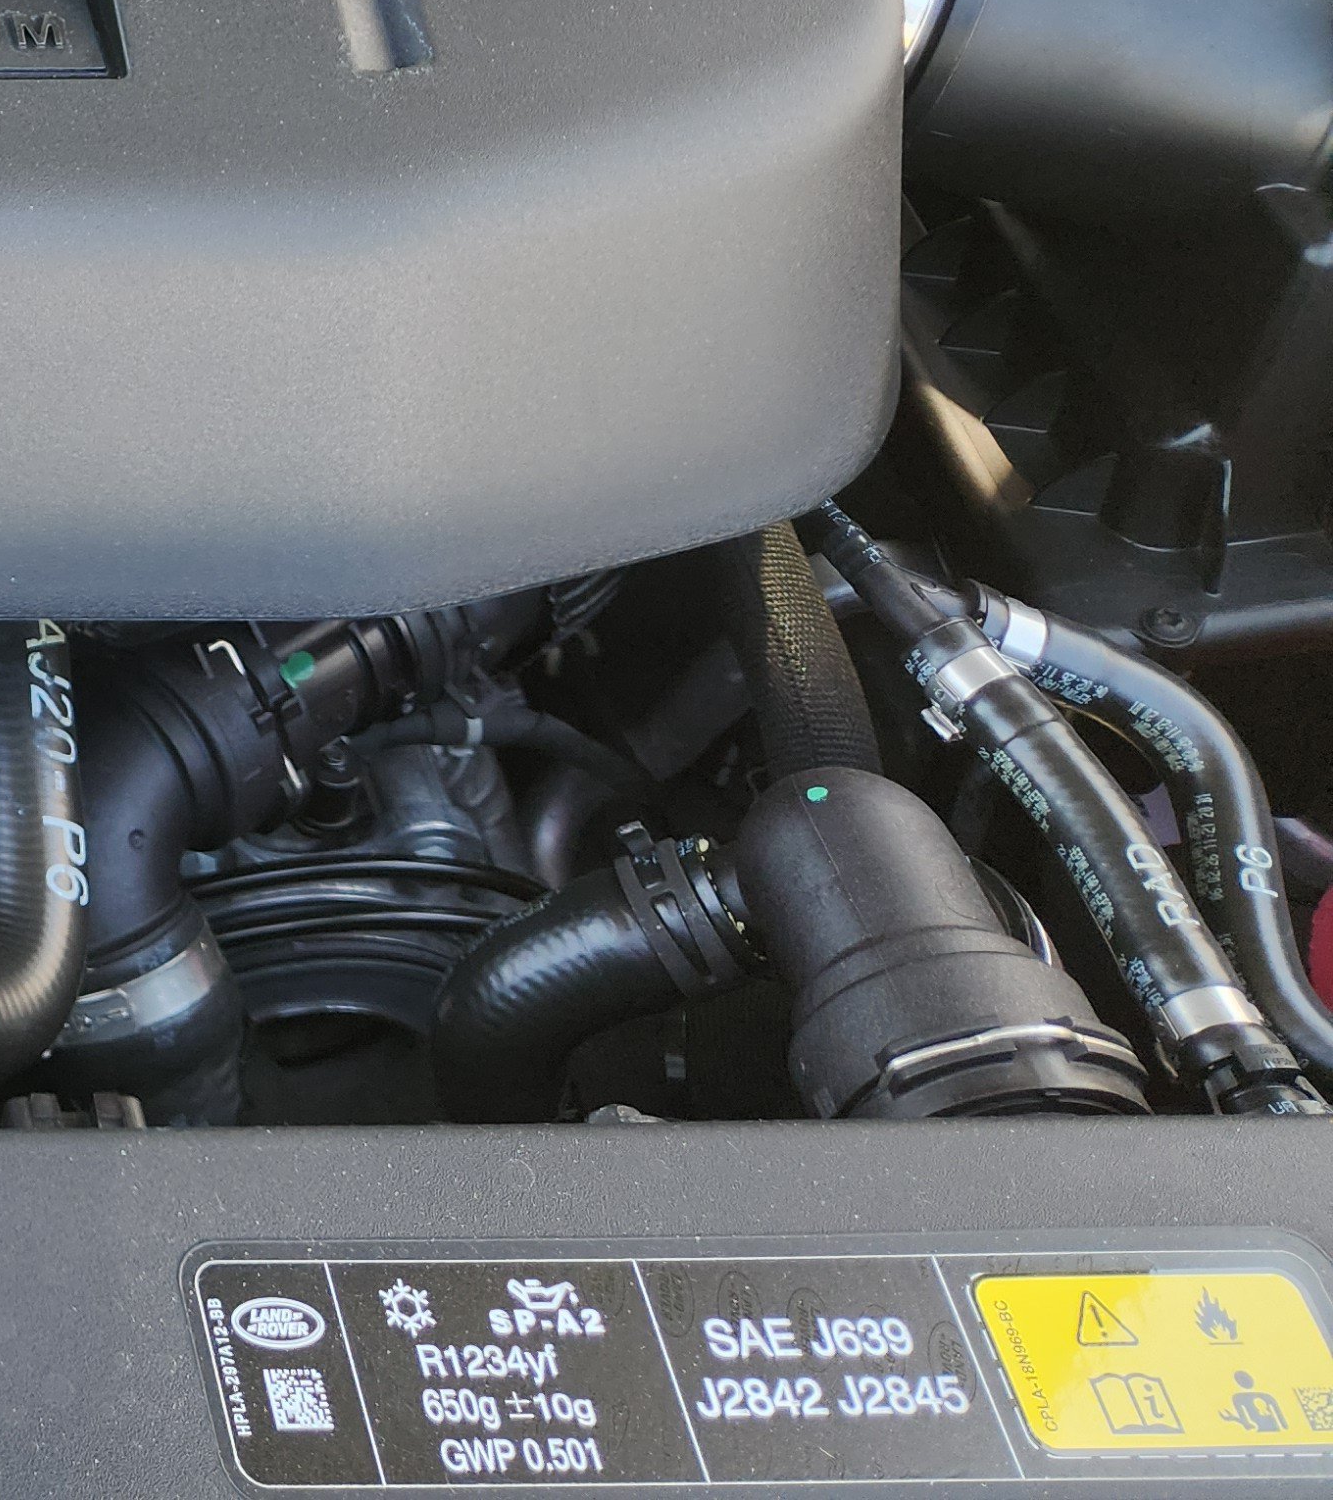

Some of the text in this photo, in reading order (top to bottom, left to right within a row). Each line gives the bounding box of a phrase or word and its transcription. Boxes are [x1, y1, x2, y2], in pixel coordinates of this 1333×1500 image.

[1126, 843, 1201, 926] RAD
[1236, 844, 1278, 898] P6
[249, 1308, 293, 1322] LAND
[256, 1321, 309, 1336] ROVER
[488, 1308, 606, 1336] SP-A2
[703, 1317, 803, 1359] SAE
[810, 1316, 914, 1358] J639
[206, 1297, 253, 1437] HPLA-297A12-BB
[415, 1343, 559, 1388] R1234yf
[994, 1299, 1059, 1432] CPLA-18N969-BC
[422, 1388, 502, 1431] 650g
[696, 1374, 970, 1418] J2842 J2845
[439, 1437, 603, 1474] GWP 0.501
